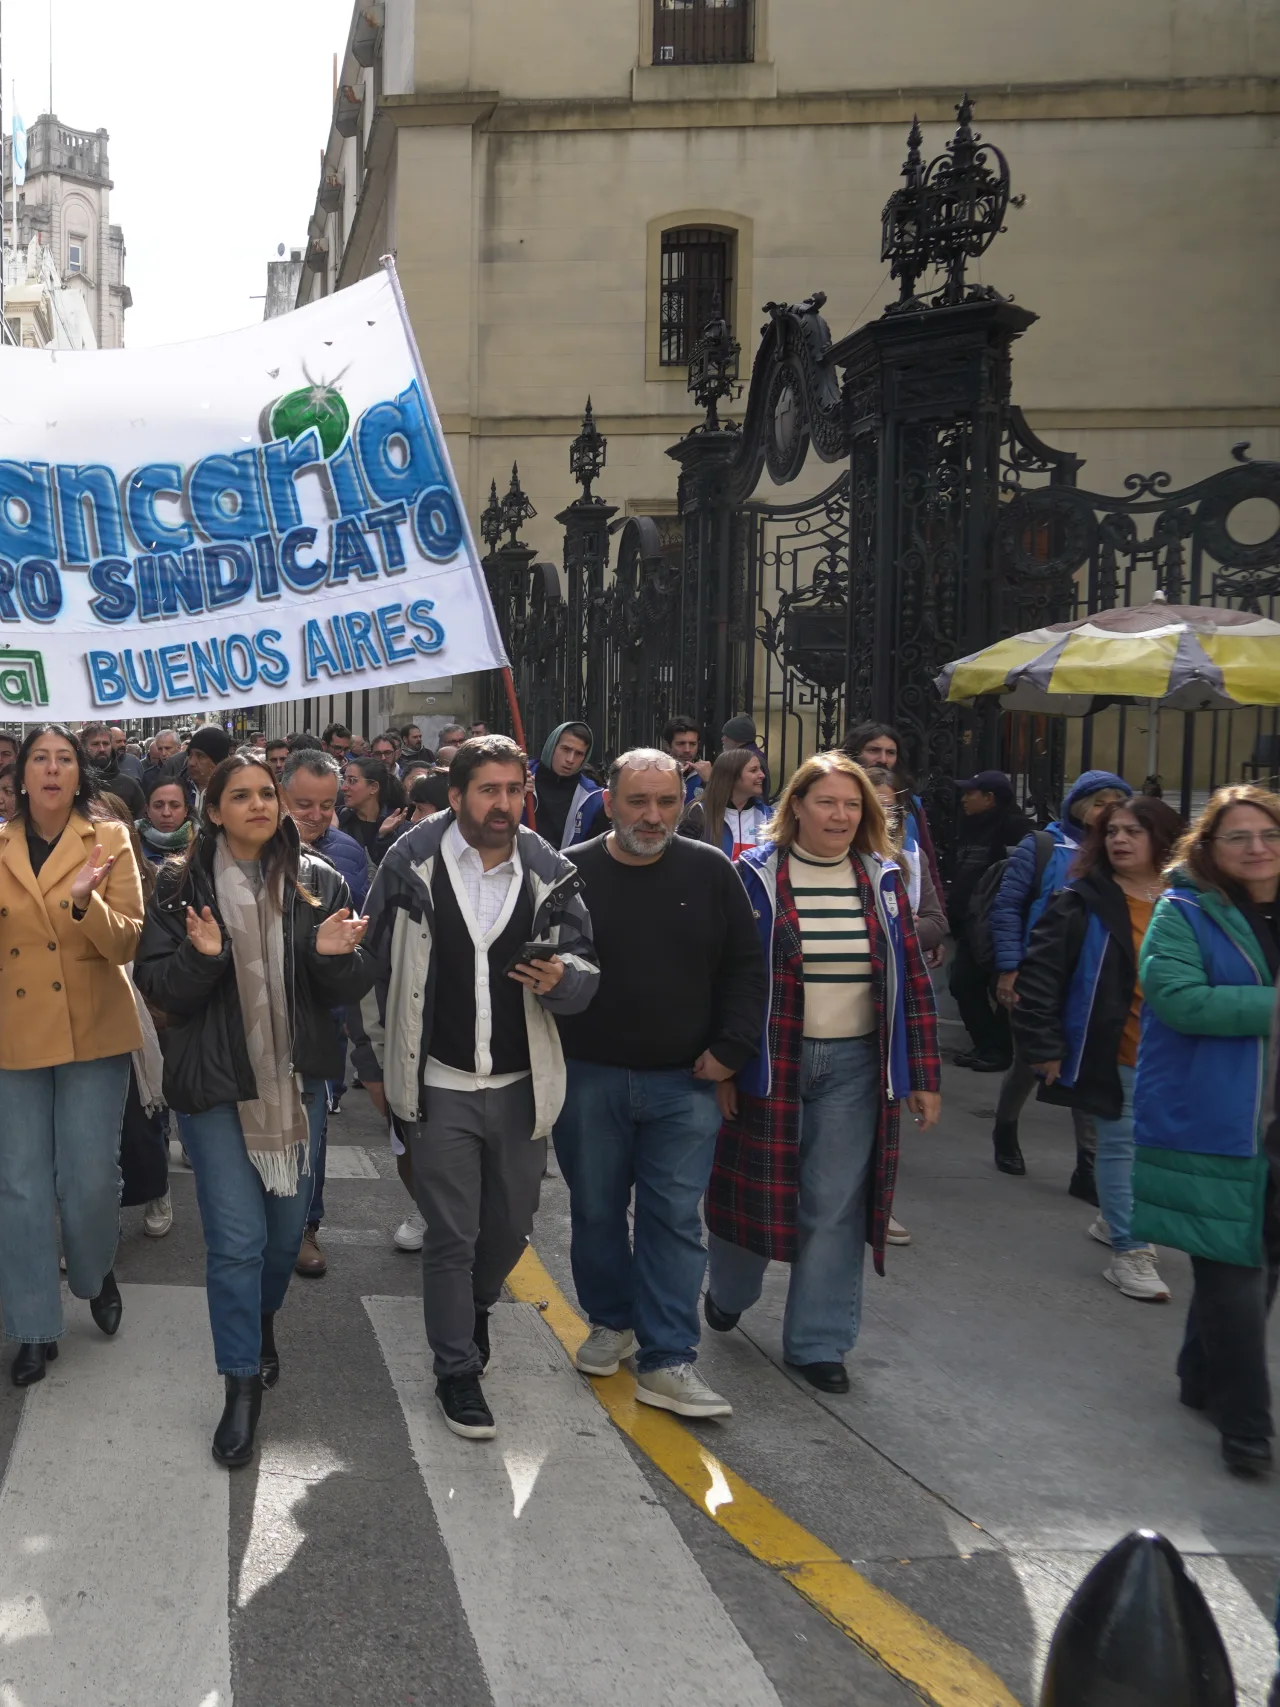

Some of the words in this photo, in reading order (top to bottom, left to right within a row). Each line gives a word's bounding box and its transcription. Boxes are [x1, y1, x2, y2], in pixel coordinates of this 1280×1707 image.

[87, 484, 463, 623] SINDICATO
[85, 628, 290, 707] BUENOS
[303, 598, 447, 679] AIRES
